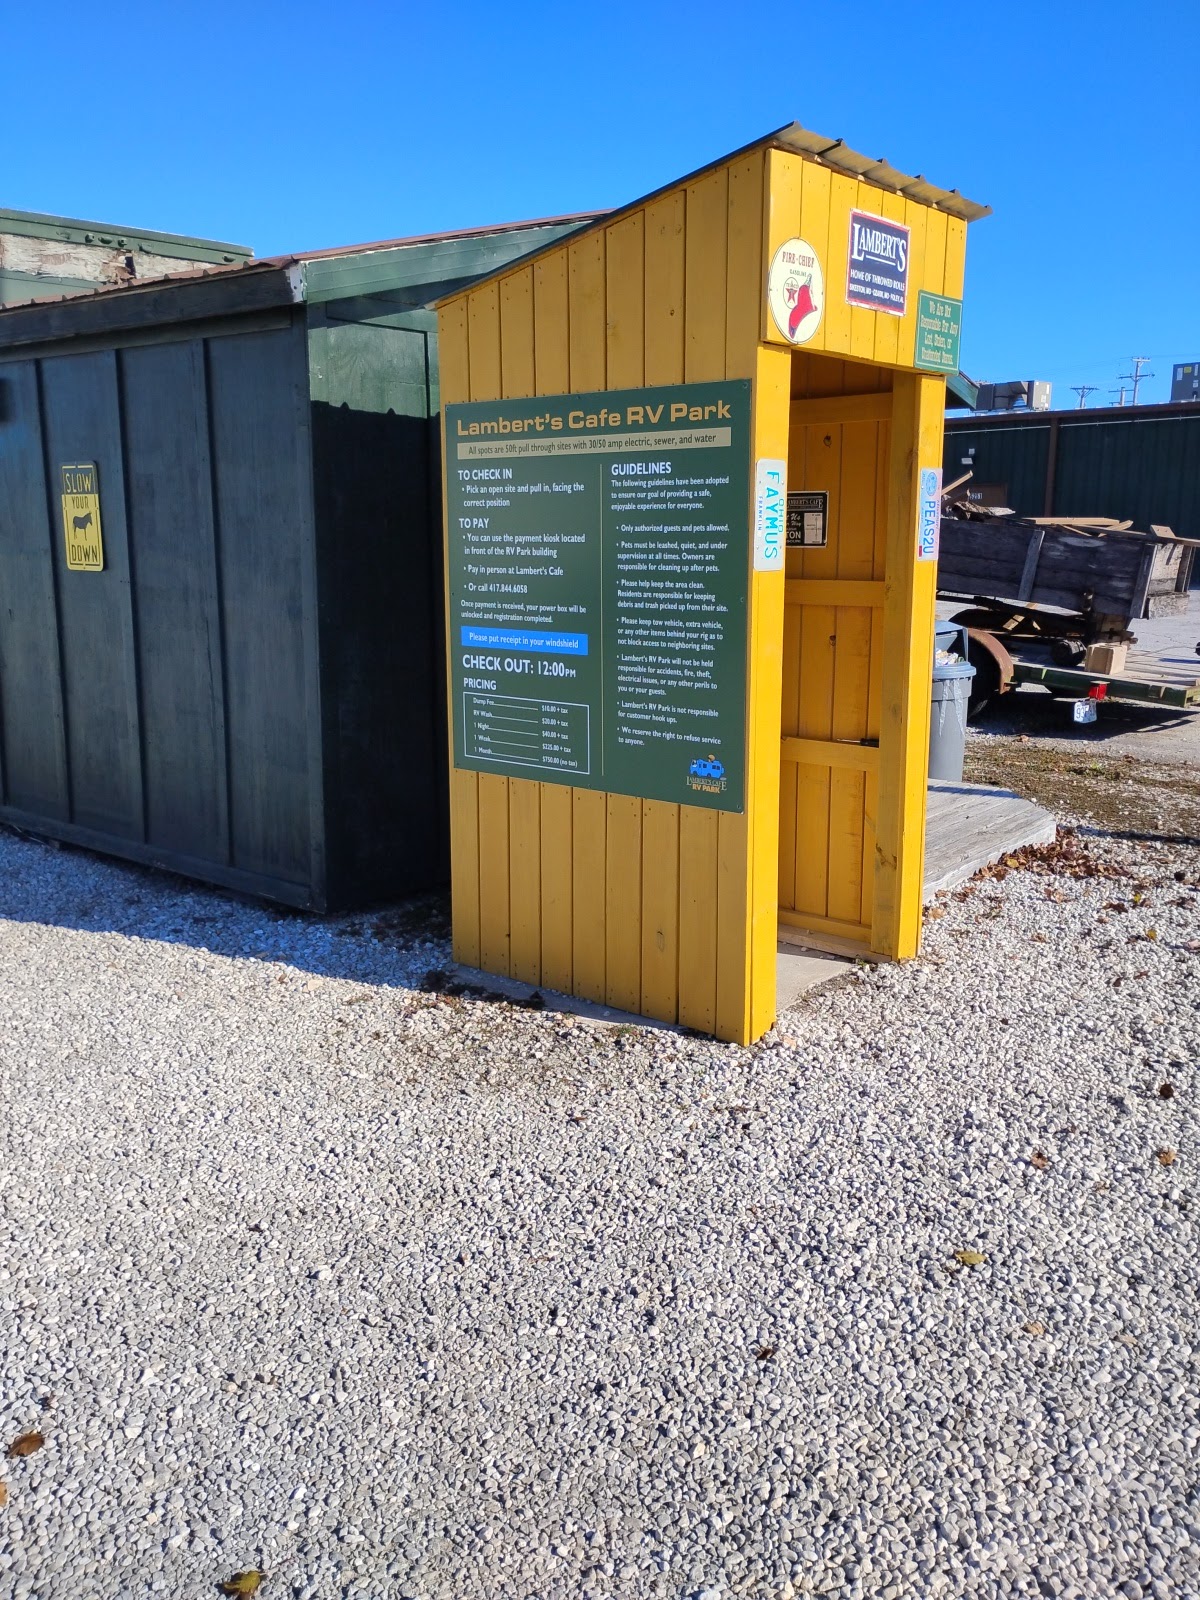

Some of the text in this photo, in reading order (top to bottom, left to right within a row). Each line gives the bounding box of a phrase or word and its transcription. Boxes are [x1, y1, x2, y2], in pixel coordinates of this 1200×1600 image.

[852, 223, 906, 272] LAMBERT'S
[851, 269, 864, 280] HOME
[865, 273, 871, 282] OF
[893, 281, 904, 291] ROLLS
[457, 400, 732, 436] Lambert's Cafe RV Park
[468, 434, 716, 456] All spots are 50ft pull through sites with 30/50 amp electric, sewer, and water
[458, 468, 512, 480] TO CHECK IN
[611, 462, 671, 476] GUIDELINES
[66, 473, 91, 492] SLOW
[466, 485, 479, 493] Pick
[489, 486, 503, 495] open
[505, 484, 515, 493] site
[517, 484, 528, 492] and
[530, 483, 541, 494] pull
[543, 483, 551, 493] in,
[553, 482, 571, 493] facing
[574, 482, 584, 491] the
[623, 479, 646, 488] following
[648, 479, 674, 487] guidelines
[690, 477, 704, 485] been
[705, 476, 729, 486] adopted
[72, 496, 89, 509] YOUR
[464, 498, 510, 508] correct position
[611, 502, 636, 511] enjoyable
[637, 502, 666, 511] experience
[765, 471, 779, 558] FAYMUS
[459, 518, 489, 528] TO PAY
[621, 525, 633, 533] Only
[634, 524, 662, 532] authorized
[664, 525, 680, 533] guests
[693, 525, 705, 533] pets
[923, 501, 936, 554] PEAS2U
[467, 533, 479, 541] You
[504, 534, 513, 542] the
[515, 534, 542, 544] payment
[544, 534, 560, 542] kiosk
[562, 534, 585, 542] located
[72, 545, 98, 562] DOWN
[465, 546, 557, 558] in front of the RV Park building
[468, 565, 478, 575] Pay
[480, 565, 485, 573] in
[487, 566, 506, 575] person
[516, 566, 547, 575] Lambert's
[549, 567, 563, 576] Cafe
[468, 583, 528, 593] Or call 417.844.6058
[469, 632, 579, 648] Please put receipt in your windshield
[462, 654, 501, 671] CHECK
[504, 658, 534, 674] OUT:
[464, 678, 496, 690] PRICING
[622, 700, 647, 709] Lambert's
[649, 702, 656, 710] RV
[658, 704, 670, 712] Park
[688, 708, 718, 717] responsible
[627, 712, 651, 720] customer
[652, 714, 665, 722] hook
[632, 728, 651, 736] reserve
[663, 732, 675, 740] right
[684, 734, 700, 742] refuse
[703, 785, 720, 793] PARK
